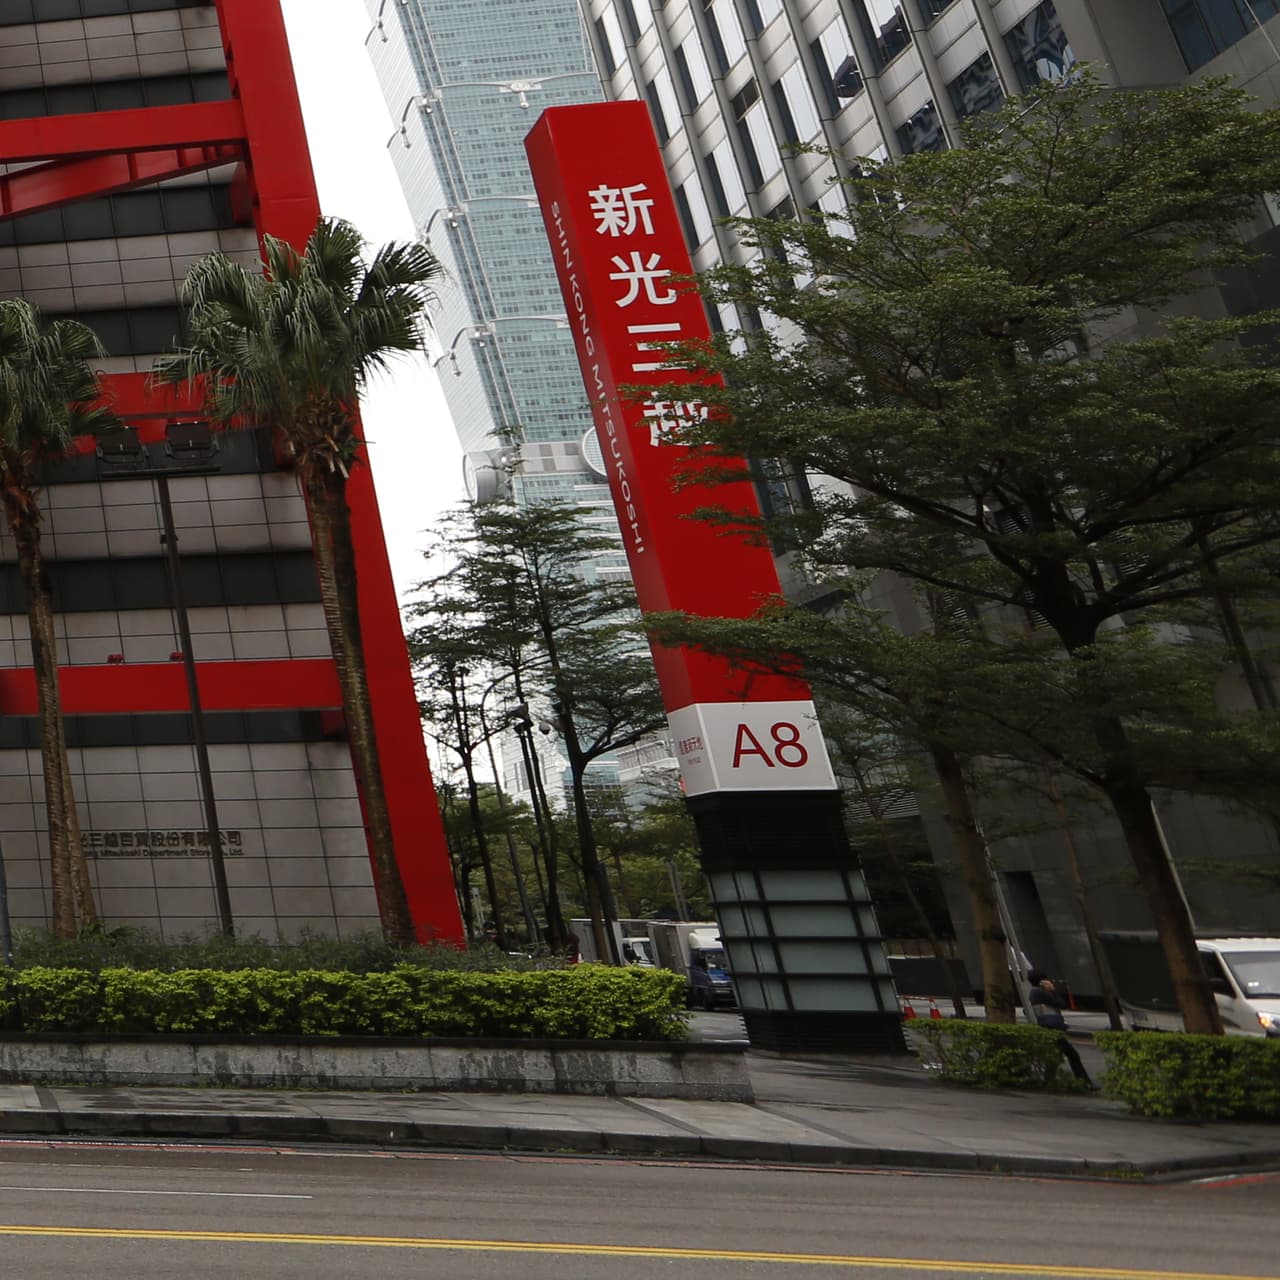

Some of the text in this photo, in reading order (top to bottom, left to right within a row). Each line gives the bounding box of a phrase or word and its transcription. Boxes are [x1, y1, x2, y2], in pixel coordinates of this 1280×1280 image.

[551, 200, 645, 554] SHIN KONG MITSUKOSHI
[732, 721, 809, 769] A8
